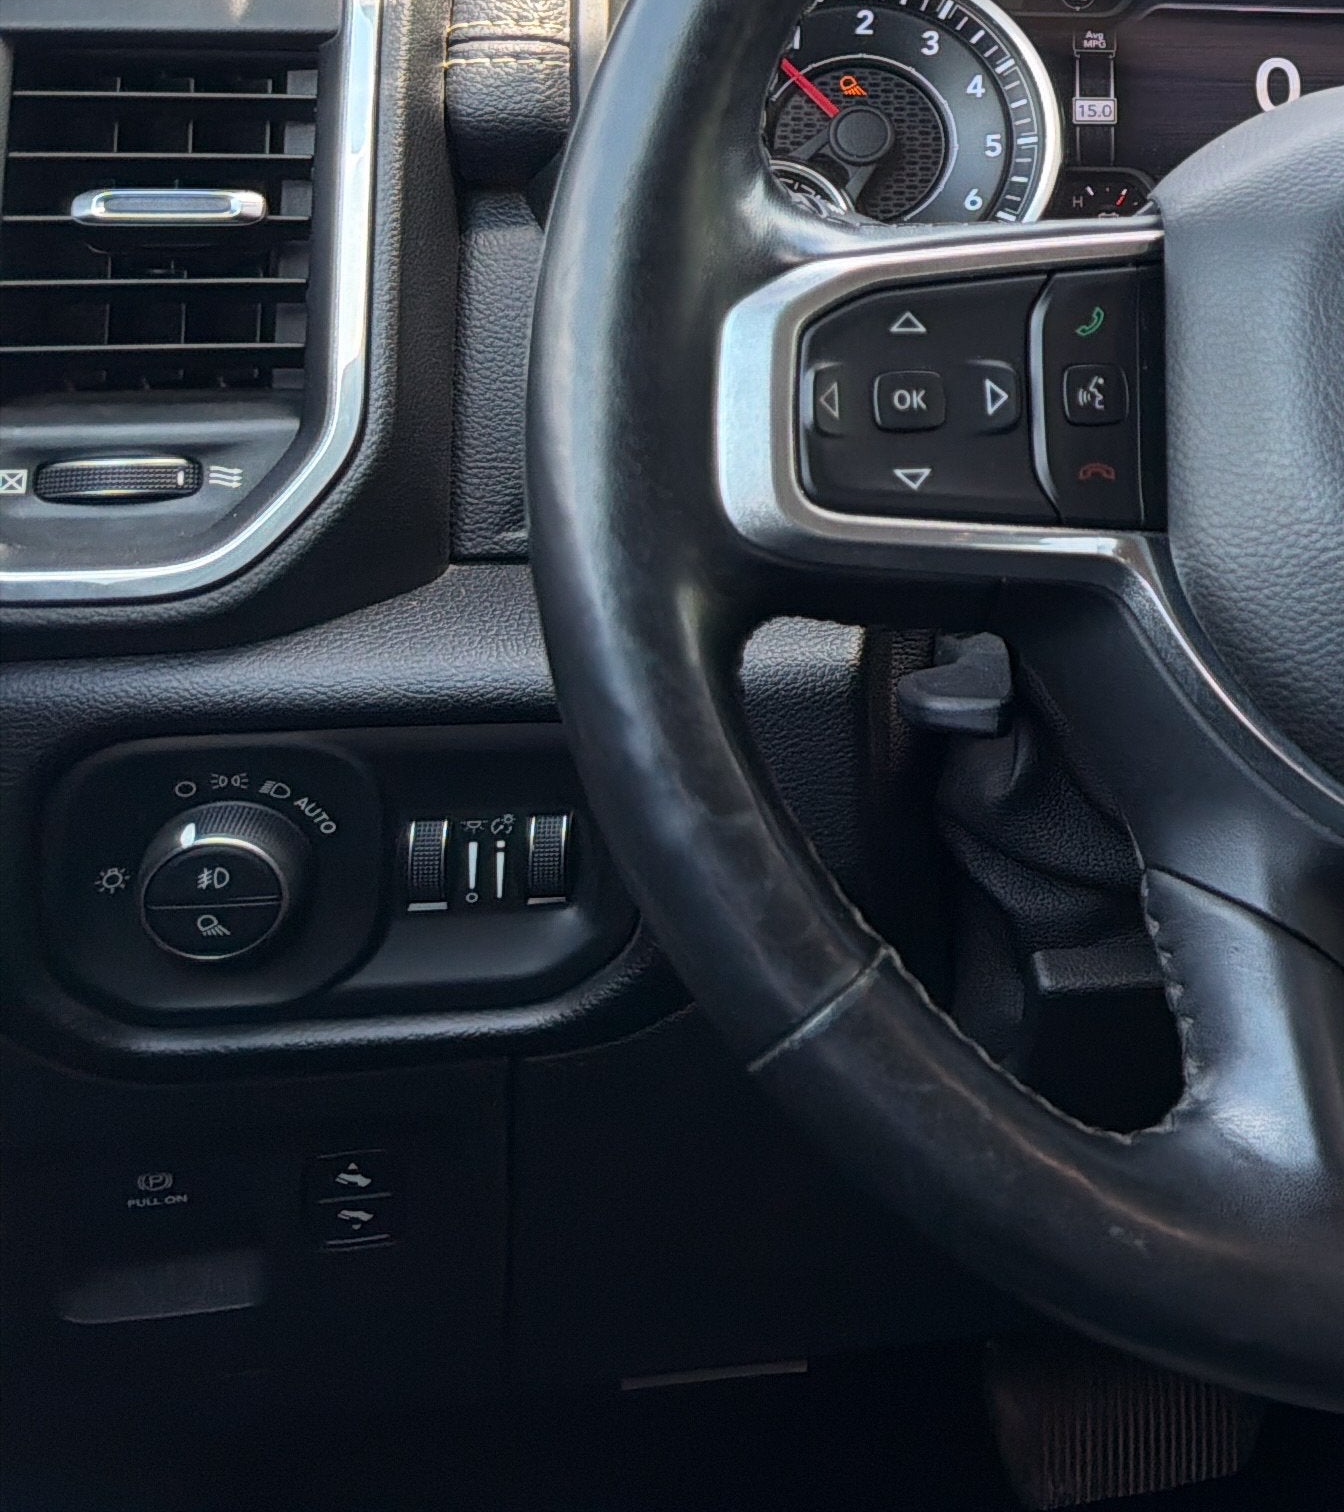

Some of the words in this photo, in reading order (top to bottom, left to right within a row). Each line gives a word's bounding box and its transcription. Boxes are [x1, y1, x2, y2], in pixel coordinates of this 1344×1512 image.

[854, 9, 874, 35] 2
[921, 30, 939, 55] 3
[1083, 39, 1107, 49] MPG
[1085, 30, 1104, 41] Avg
[966, 74, 986, 98] 4
[1255, 57, 1301, 112] 0
[1078, 104, 1113, 118] 15.0
[984, 133, 1003, 158] 5
[964, 188, 984, 211] 6
[1072, 195, 1084, 208] H
[892, 390, 927, 411] OK
[293, 796, 338, 836] AUTO
[127, 1197, 162, 1208] PULL
[164, 1194, 189, 1205] ON
